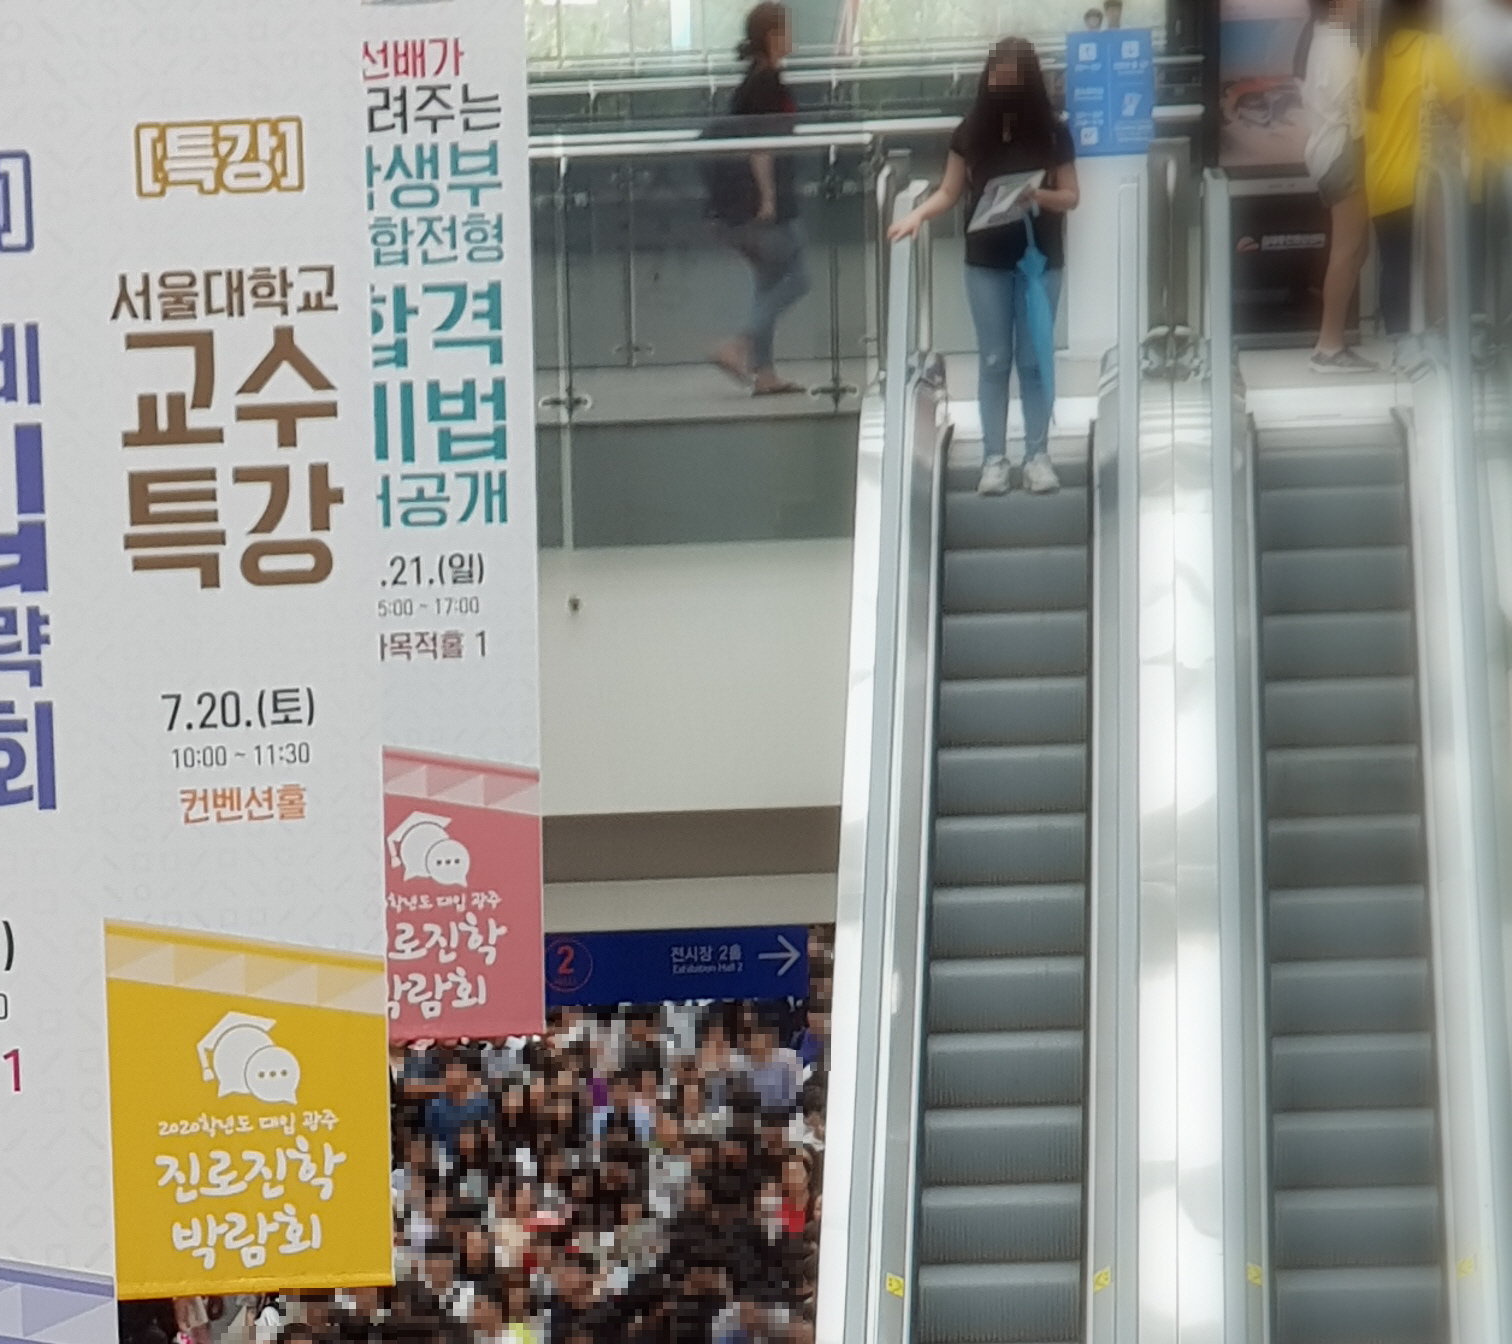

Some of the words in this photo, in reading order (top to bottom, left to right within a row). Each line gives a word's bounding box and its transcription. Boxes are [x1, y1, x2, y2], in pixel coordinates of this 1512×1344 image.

[362, 37, 464, 81] 선배가
[134, 115, 305, 199] [특강]
[109, 264, 339, 321] 서울대학교
[121, 325, 338, 449] 교수
[123, 462, 344, 589] 특강
[435, 597, 479, 615] 17:00
[475, 631, 486, 657] 1
[161, 687, 314, 731] 7.20.(토)
[172, 746, 227, 768] 10:00
[255, 742, 310, 765] 11:30
[179, 783, 306, 825] 컨벤션홀
[557, 945, 574, 975] 2
[2, 1048, 21, 1092] 1
[259, 1113, 296, 1135] 대입
[302, 1109, 339, 1132] 광주
[155, 1135, 347, 1204] 진로진학
[172, 1203, 322, 1269] 박람회
